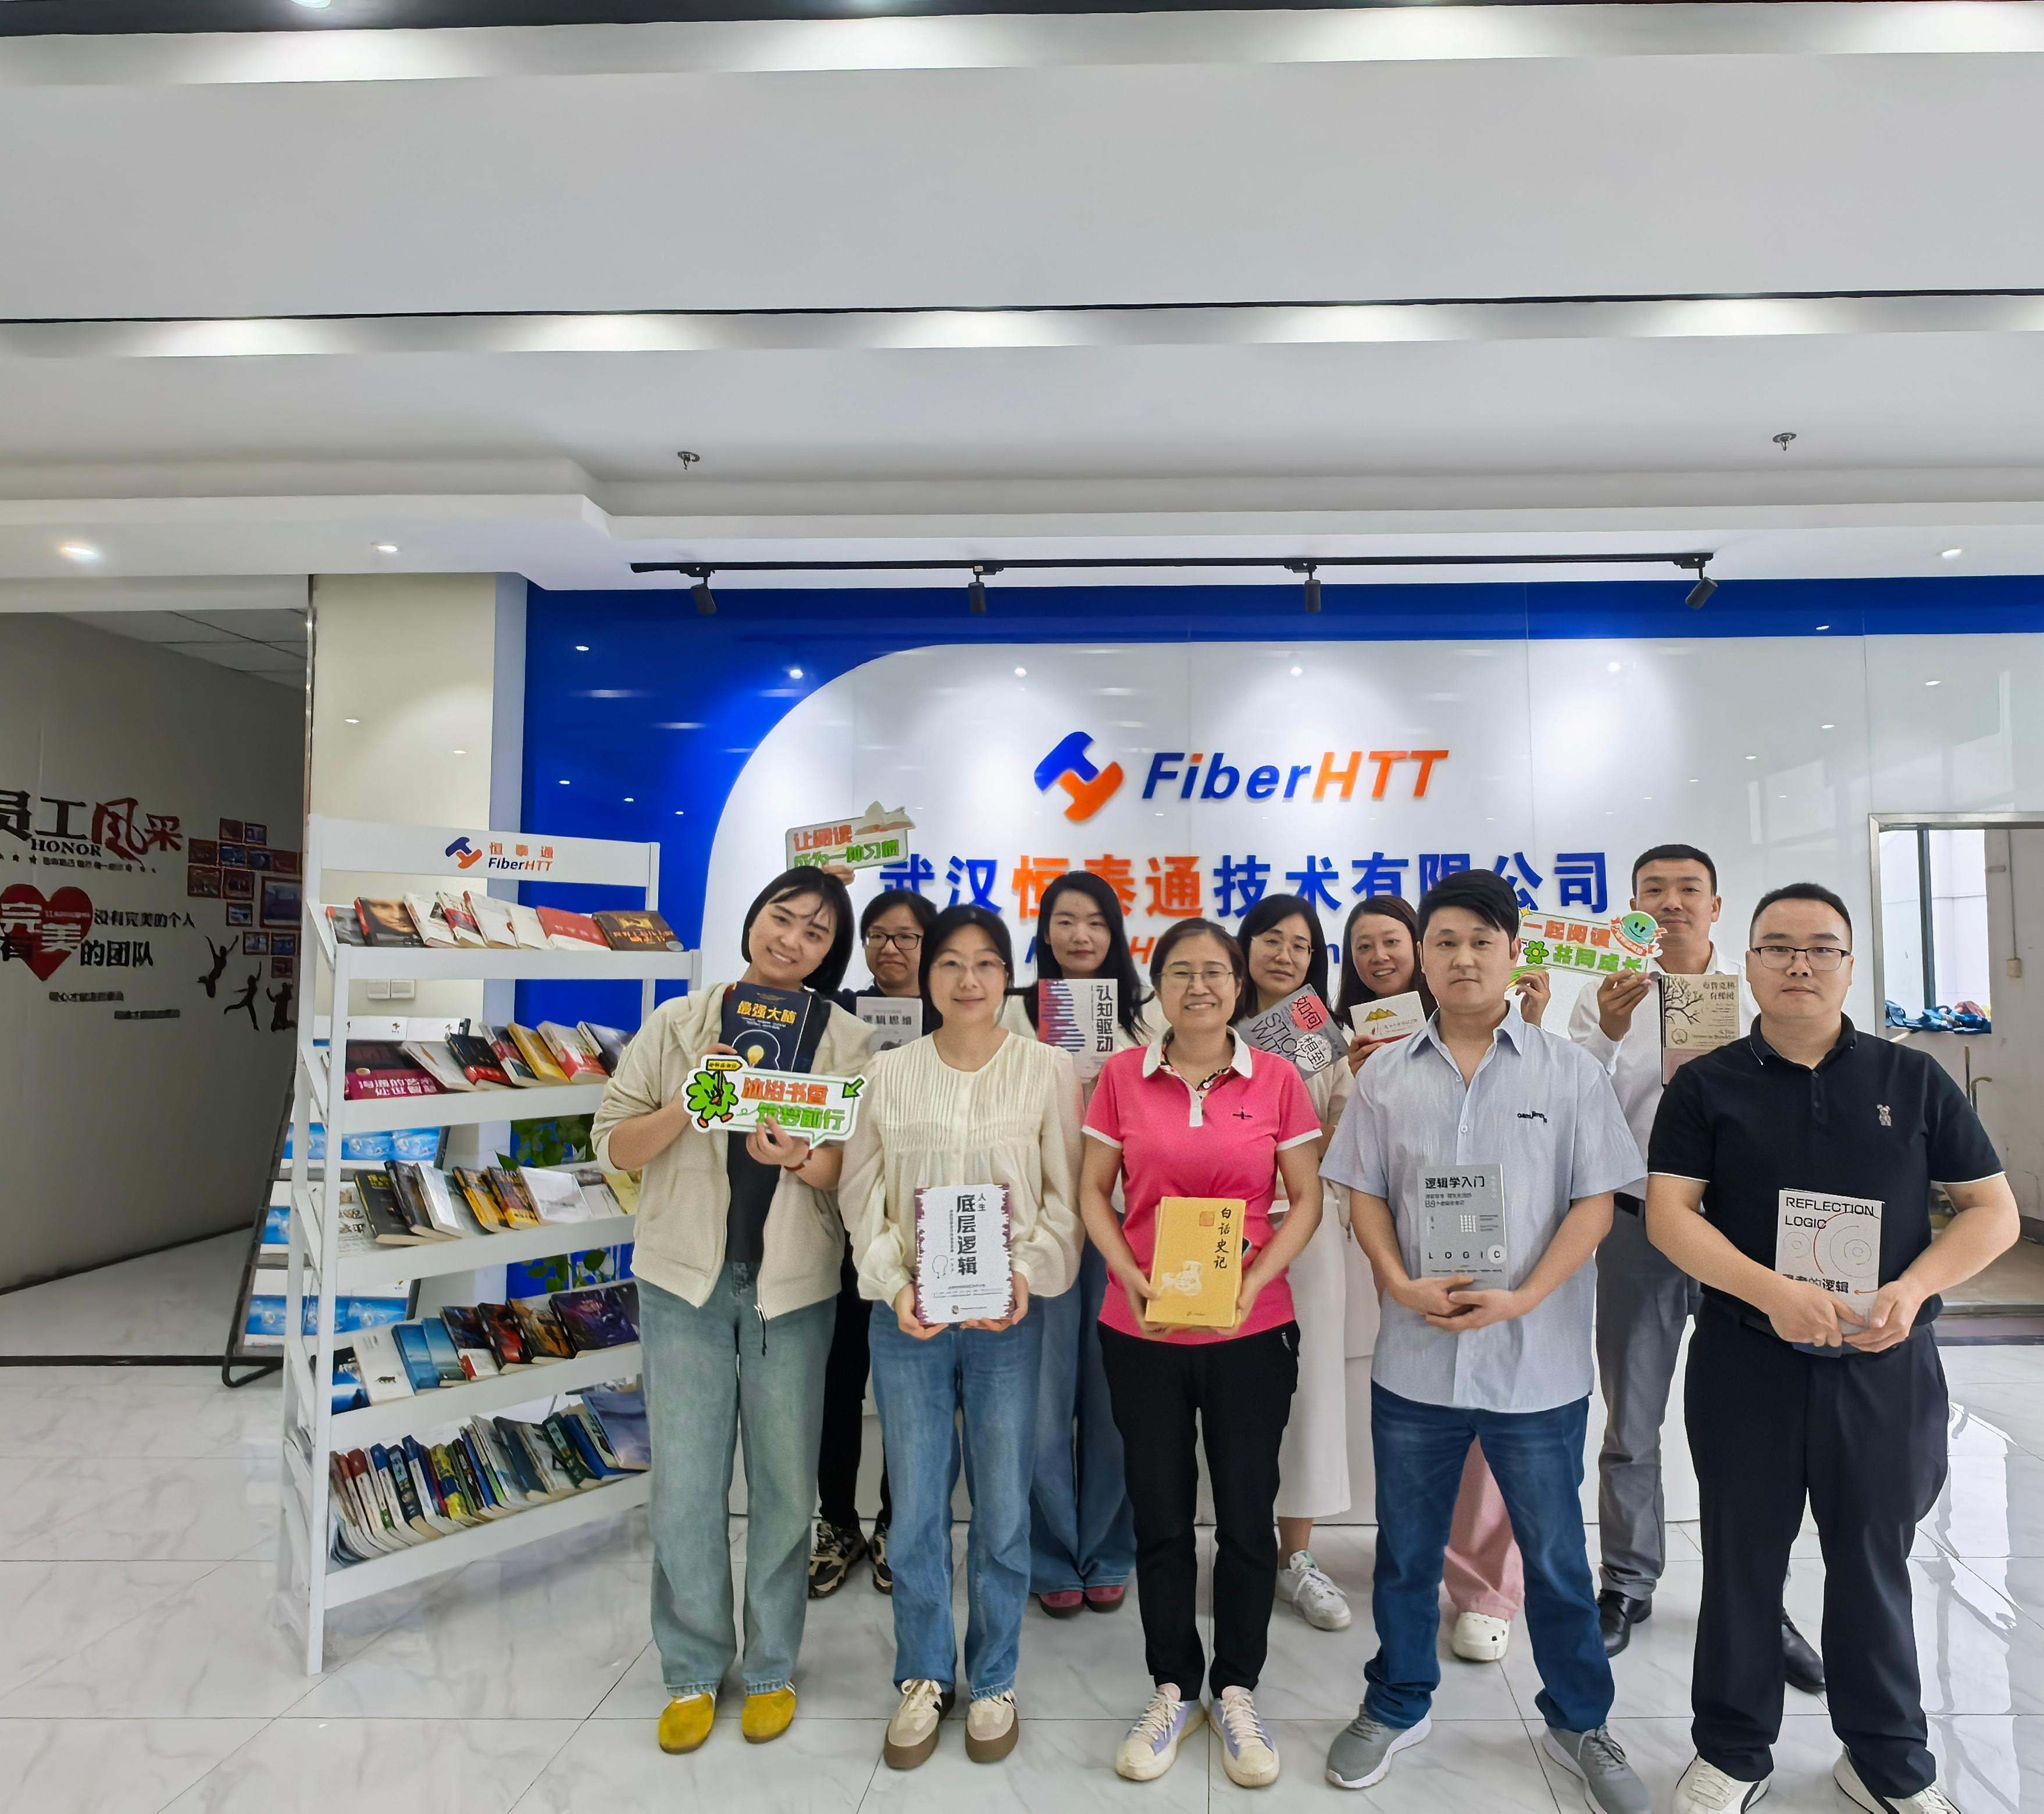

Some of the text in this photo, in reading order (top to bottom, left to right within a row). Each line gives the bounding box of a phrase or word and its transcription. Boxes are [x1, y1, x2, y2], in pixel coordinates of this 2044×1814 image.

[1142, 749, 1450, 799] FiberHTT
[31, 838, 102, 858] HONOR
[488, 857, 553, 872] FiberHTT
[737, 1000, 797, 1024] 最强大脑
[1096, 984, 1114, 1052] 认知驱动
[1292, 995, 1324, 1029] 如何
[1251, 1020, 1282, 1052] WIT
[1265, 1012, 1307, 1063] STICK
[1299, 1035, 1329, 1070] 想到
[1425, 1175, 1485, 1189] 逻辑学入门
[977, 1192, 987, 1212] 人生
[1786, 1197, 1874, 1216] REFLECTION
[1785, 1215, 1827, 1230] LOGIC
[957, 1194, 978, 1276] 底层逻辑
[1214, 1207, 1232, 1269] 白话史记
[1428, 1251, 1501, 1260] LOGIC
[1782, 1273, 1849, 1294] 的逻辑
